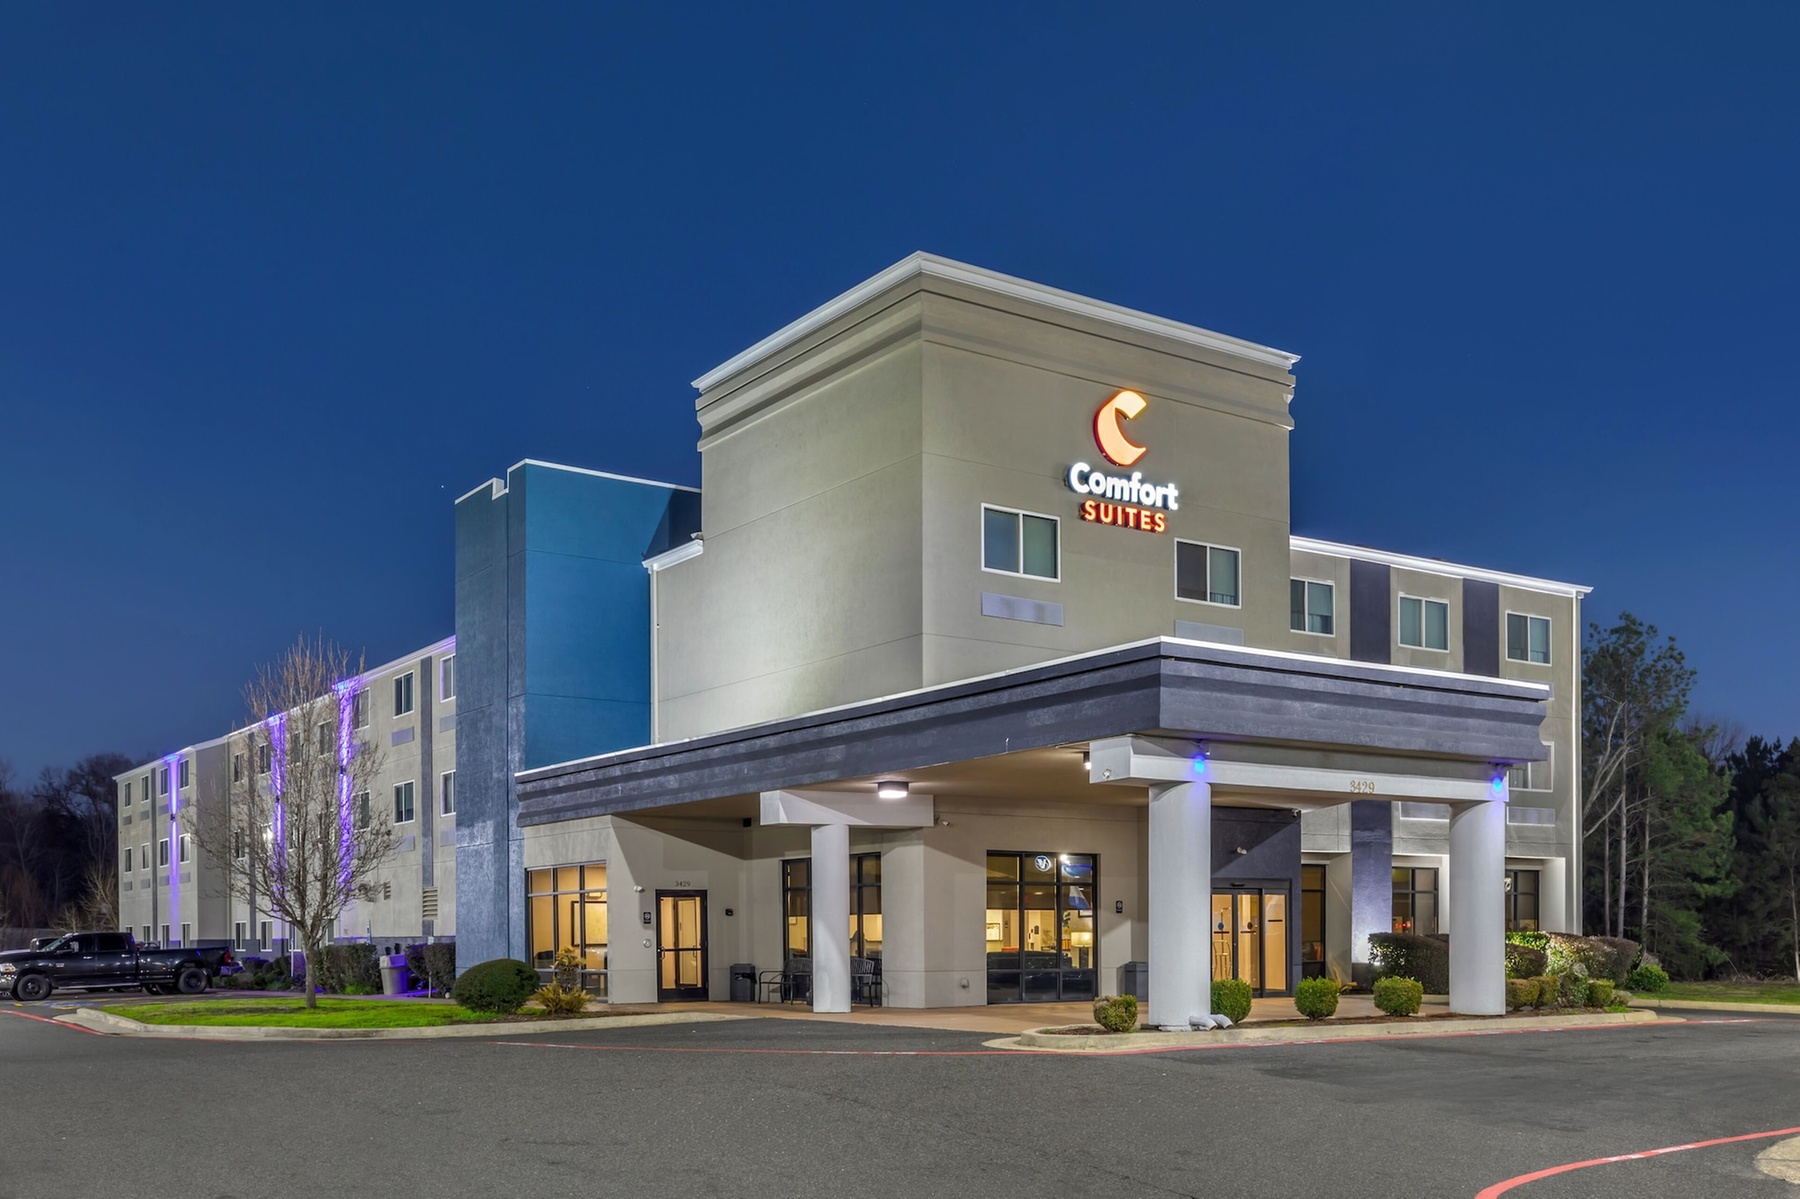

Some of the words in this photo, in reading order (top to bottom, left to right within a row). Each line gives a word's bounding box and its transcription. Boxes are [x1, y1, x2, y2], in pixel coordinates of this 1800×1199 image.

[1068, 461, 1179, 511] Comfort
[1082, 499, 1166, 533] SUITES
[1350, 779, 1375, 794] 3429
[674, 880, 691, 888] 3429
